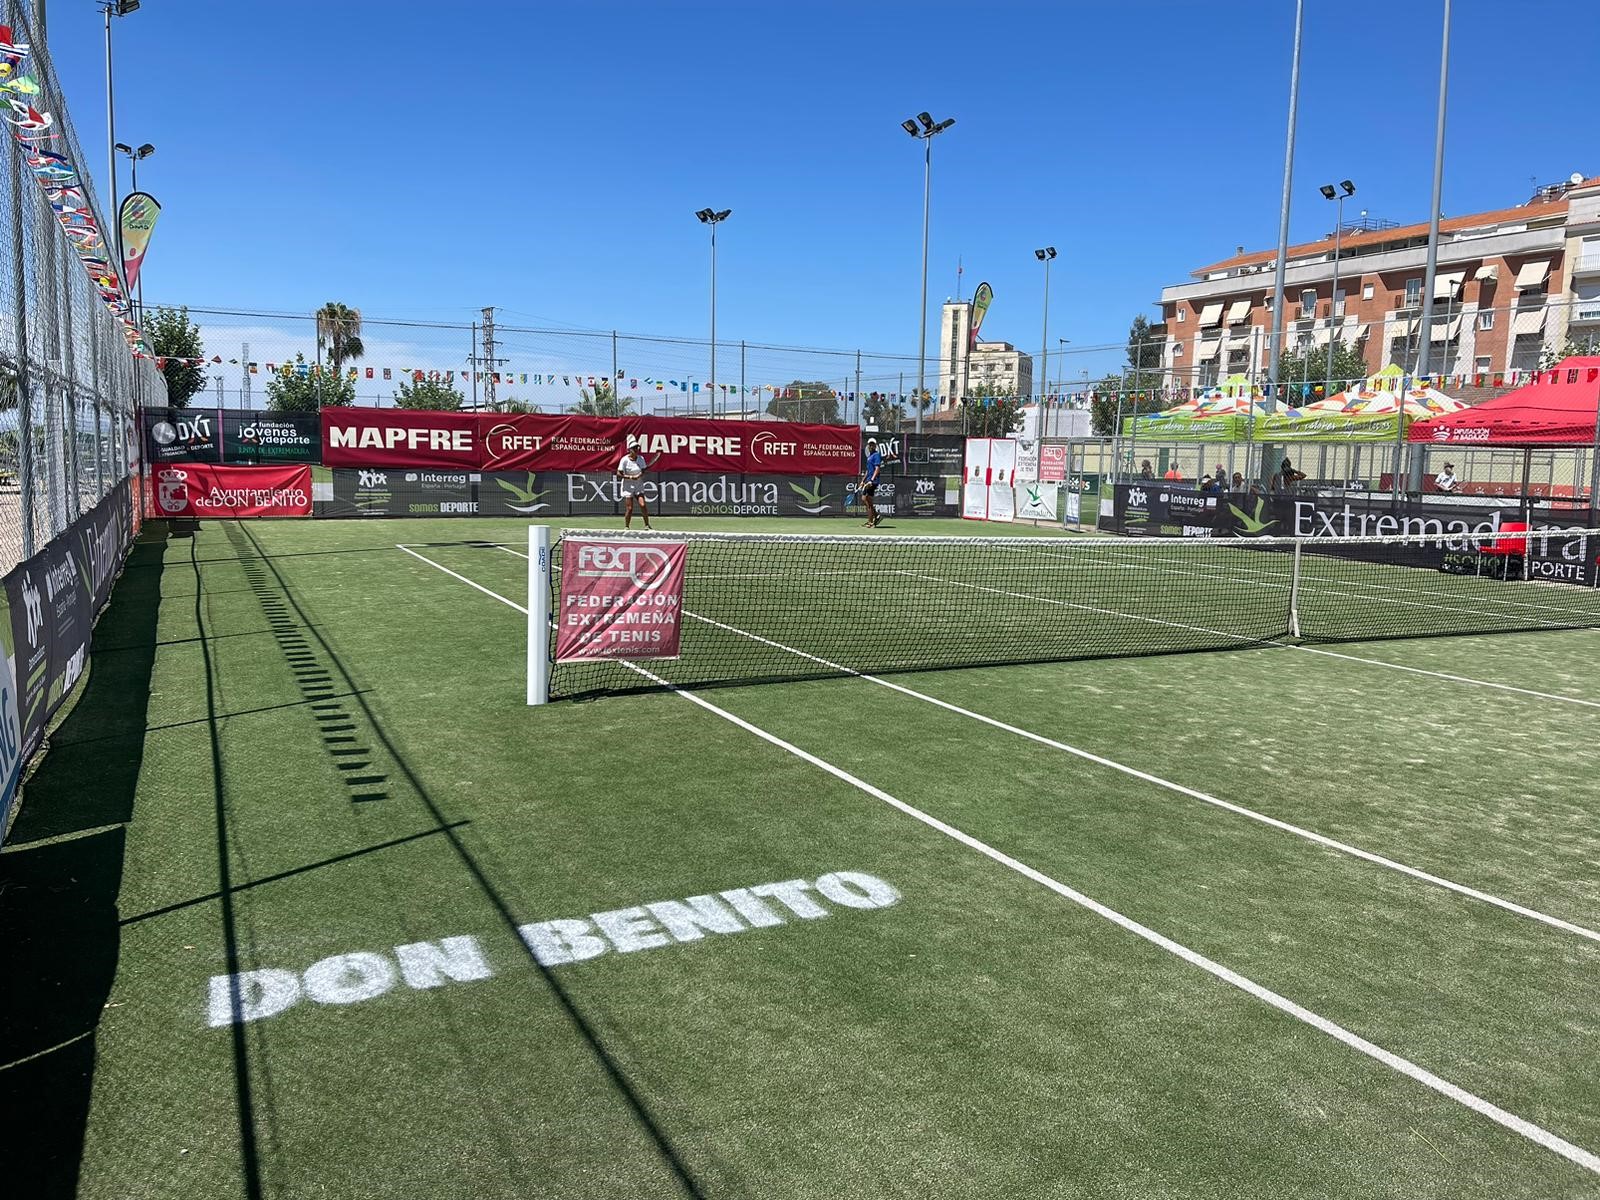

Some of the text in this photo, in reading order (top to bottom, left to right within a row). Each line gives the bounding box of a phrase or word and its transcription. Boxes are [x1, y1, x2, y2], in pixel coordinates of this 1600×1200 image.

[178, 415, 211, 441] DXT
[238, 422, 297, 438] jóvenes
[1453, 426, 1490, 435] DIPUTACIÓN
[259, 436, 310, 446] ydeporte
[329, 426, 473, 451] MAPFRE
[502, 436, 542, 450] RFET
[551, 436, 611, 444] REAL FEDERACIÓN
[626, 434, 741, 456] MAPFRE
[551, 443, 586, 451] ESPAÑOLA
[764, 443, 797, 455] RFET
[818, 443, 853, 451] FEDERACIÓN
[879, 438, 900, 456] DXT
[421, 473, 466, 484] Interreg
[210, 486, 304, 500] Ayuntamiento
[566, 474, 778, 504] Extemadura
[255, 495, 308, 507] BENITO
[440, 502, 478, 512] DEPORTE
[1170, 494, 1204, 507] Interreg
[690, 505, 778, 515] #SOMOSDEPORTE
[1294, 501, 1588, 562] Extremadra
[566, 592, 678, 607] FEDERACIÓN
[567, 610, 675, 626] EXTREMEÑA
[580, 630, 661, 644] DE TENIS
[205, 870, 902, 1030] DON BENITO
